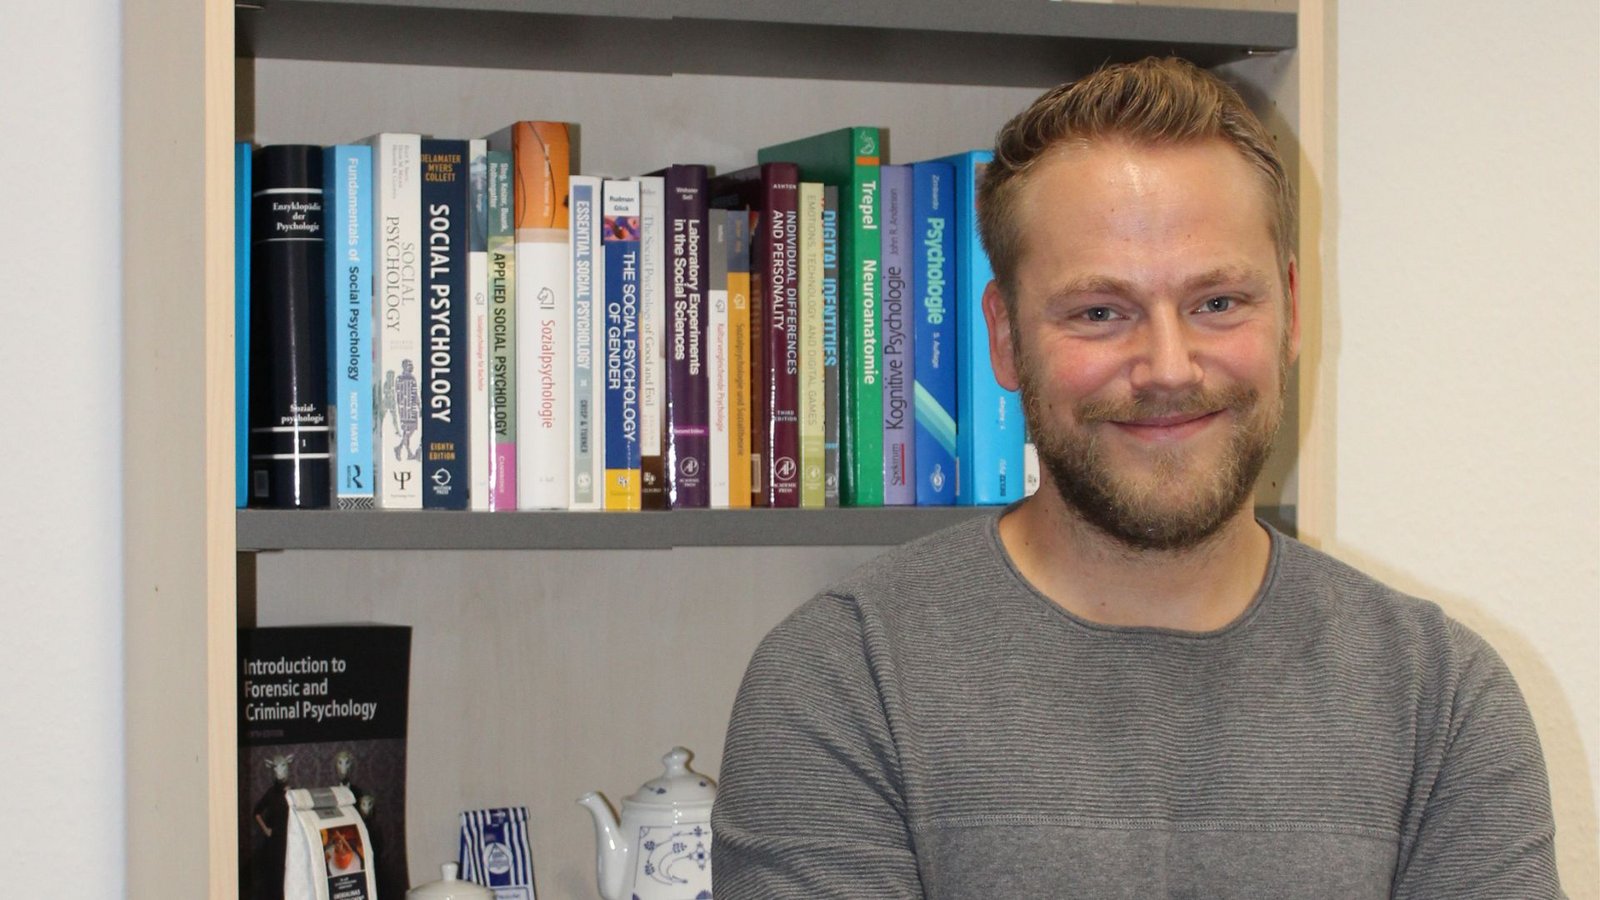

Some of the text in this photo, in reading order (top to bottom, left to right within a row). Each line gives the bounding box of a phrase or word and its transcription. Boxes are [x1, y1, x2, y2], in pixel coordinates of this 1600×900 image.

[425, 173, 456, 182] COLLETT
[428, 164, 453, 172] MYERS
[276, 222, 320, 232] Psychologie
[292, 212, 306, 220] der
[859, 181, 878, 230] Trepel
[347, 158, 360, 381] Fundamentals of Social Psychology
[386, 216, 401, 332] PSYCHOLOGY
[402, 242, 415, 306] SOCIAL
[576, 201, 590, 369] ESSENTIAL SOCIAL PSYCHOLOGY
[674, 219, 688, 360] in the Social Sciences
[684, 219, 701, 375] Laboratory Experiments
[773, 210, 785, 330] AND PERSONALITY
[786, 211, 798, 375] INDIVIDUAL DIFFERENCES
[924, 217, 946, 324] Psychologie
[430, 204, 452, 423] SOCIAL PSYCHOLOGY
[644, 323, 655, 335] of
[807, 195, 817, 426] EMOTIONS, TECHNOLOGY, AND DIGITAL GAMES
[863, 260, 879, 384] Neuroanatomie
[494, 253, 507, 436] APPLIED SOCIAL PSYCHOLOGY
[538, 319, 556, 429] Sozialpsychologie
[608, 303, 620, 389] OF GENDER
[623, 251, 636, 441] THE SOCIAL PSYCHOLOGY
[644, 336, 656, 364] Good
[644, 367, 655, 385] and
[883, 266, 907, 430] Kognitive Psychologie
[350, 391, 359, 454] NICKY HAYES
[644, 387, 656, 406] Evil
[429, 452, 456, 460] EDITION
[430, 443, 454, 451] EIGHTH
[890, 443, 902, 487] Spektrum
[243, 656, 346, 675] Introduction to
[244, 677, 328, 698] Forensic and
[245, 698, 377, 722] Criminal Psychology
